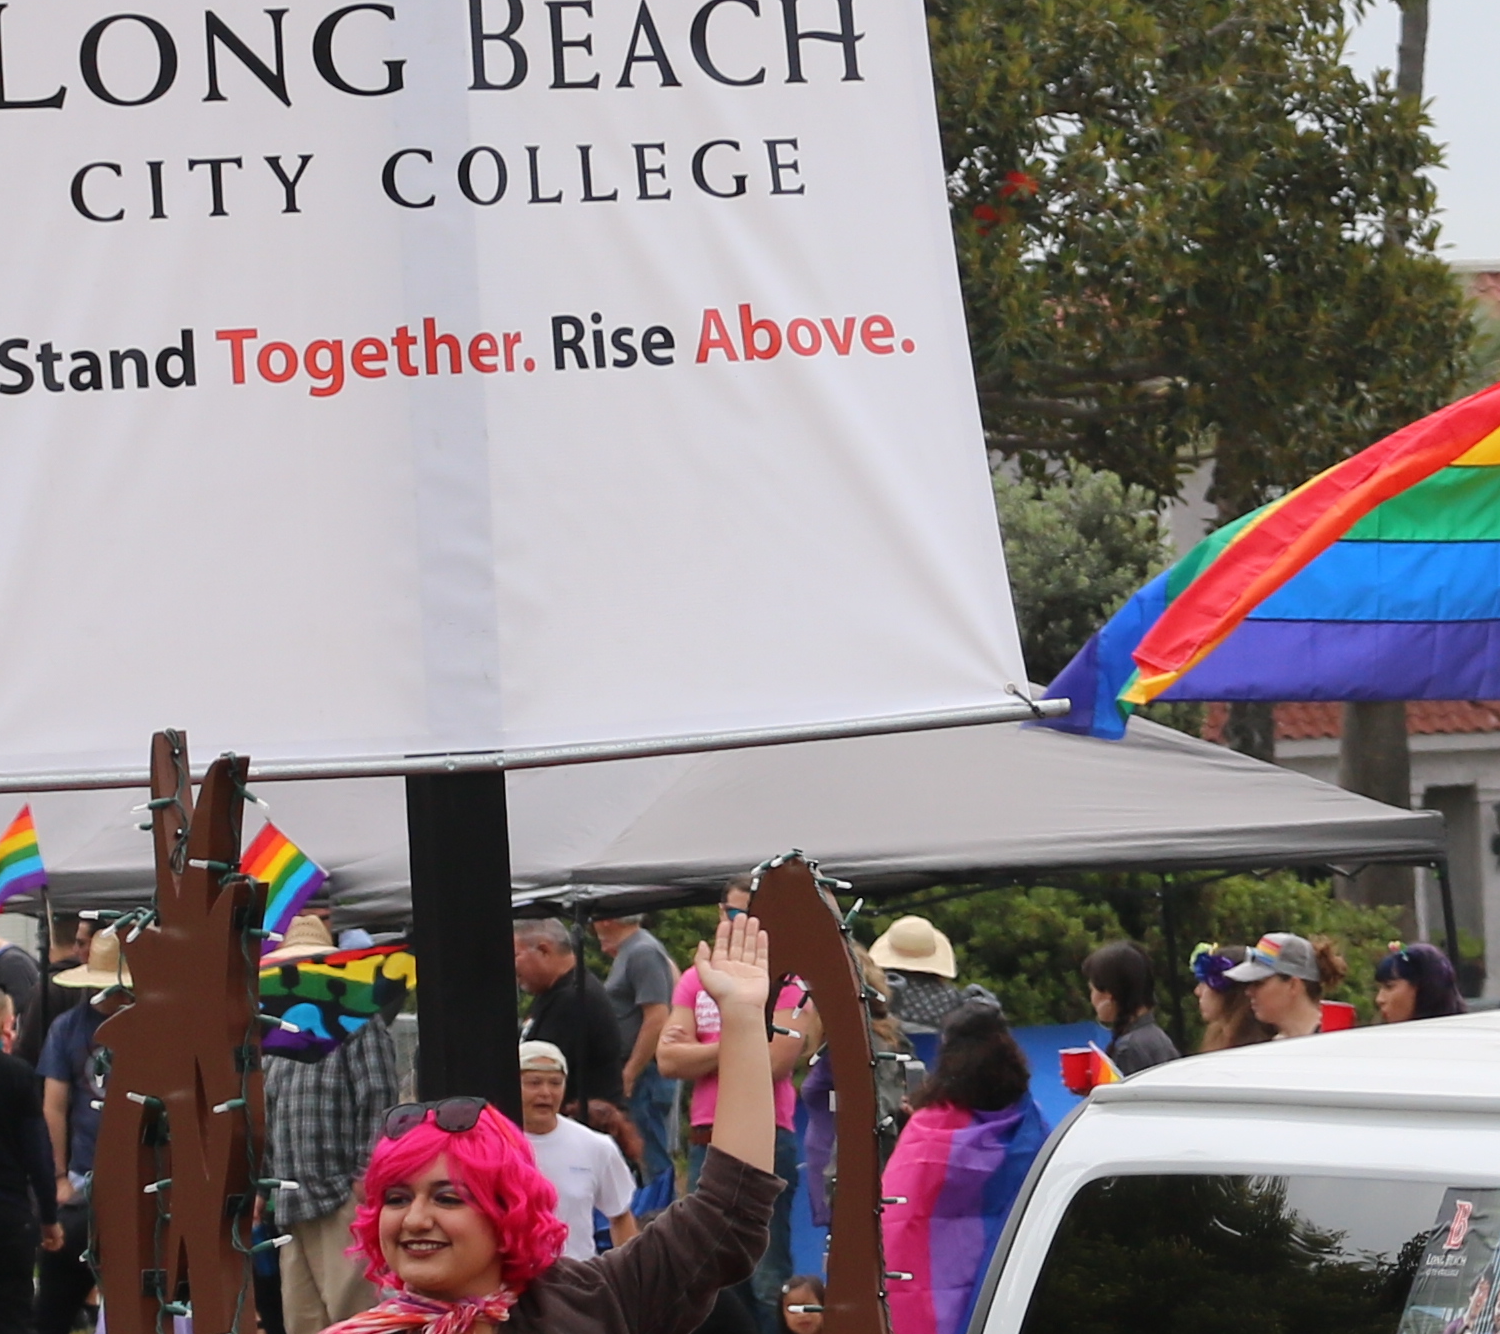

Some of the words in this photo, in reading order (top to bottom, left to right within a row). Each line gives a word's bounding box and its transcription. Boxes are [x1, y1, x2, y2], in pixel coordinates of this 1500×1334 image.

[70, 153, 314, 221] CITY
[381, 137, 807, 208] COLLEGE
[216, 317, 536, 397] Together.
[551, 313, 675, 371] Rise
[694, 303, 916, 365] Above.
